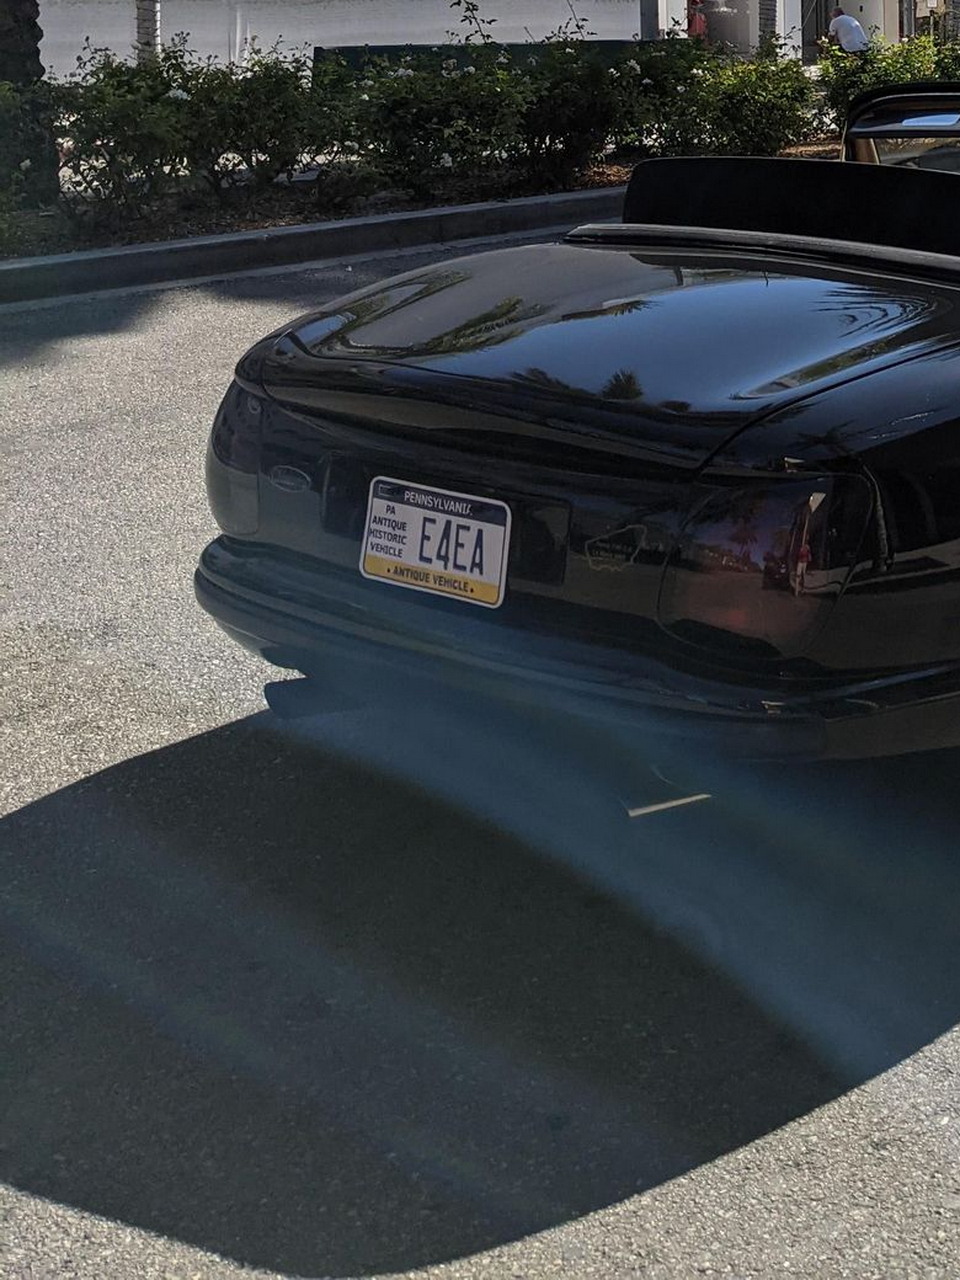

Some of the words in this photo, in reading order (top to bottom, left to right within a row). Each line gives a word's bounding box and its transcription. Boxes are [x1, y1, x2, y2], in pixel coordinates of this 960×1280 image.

[385, 504, 396, 515] PA
[372, 516, 407, 532] ANTIQUE
[369, 528, 407, 545] HISTORIC
[370, 541, 403, 558] VEHICLE
[419, 516, 484, 576] E4EA
[393, 566, 430, 583] ANTIQUE
[432, 574, 469, 593] VEHICLE
